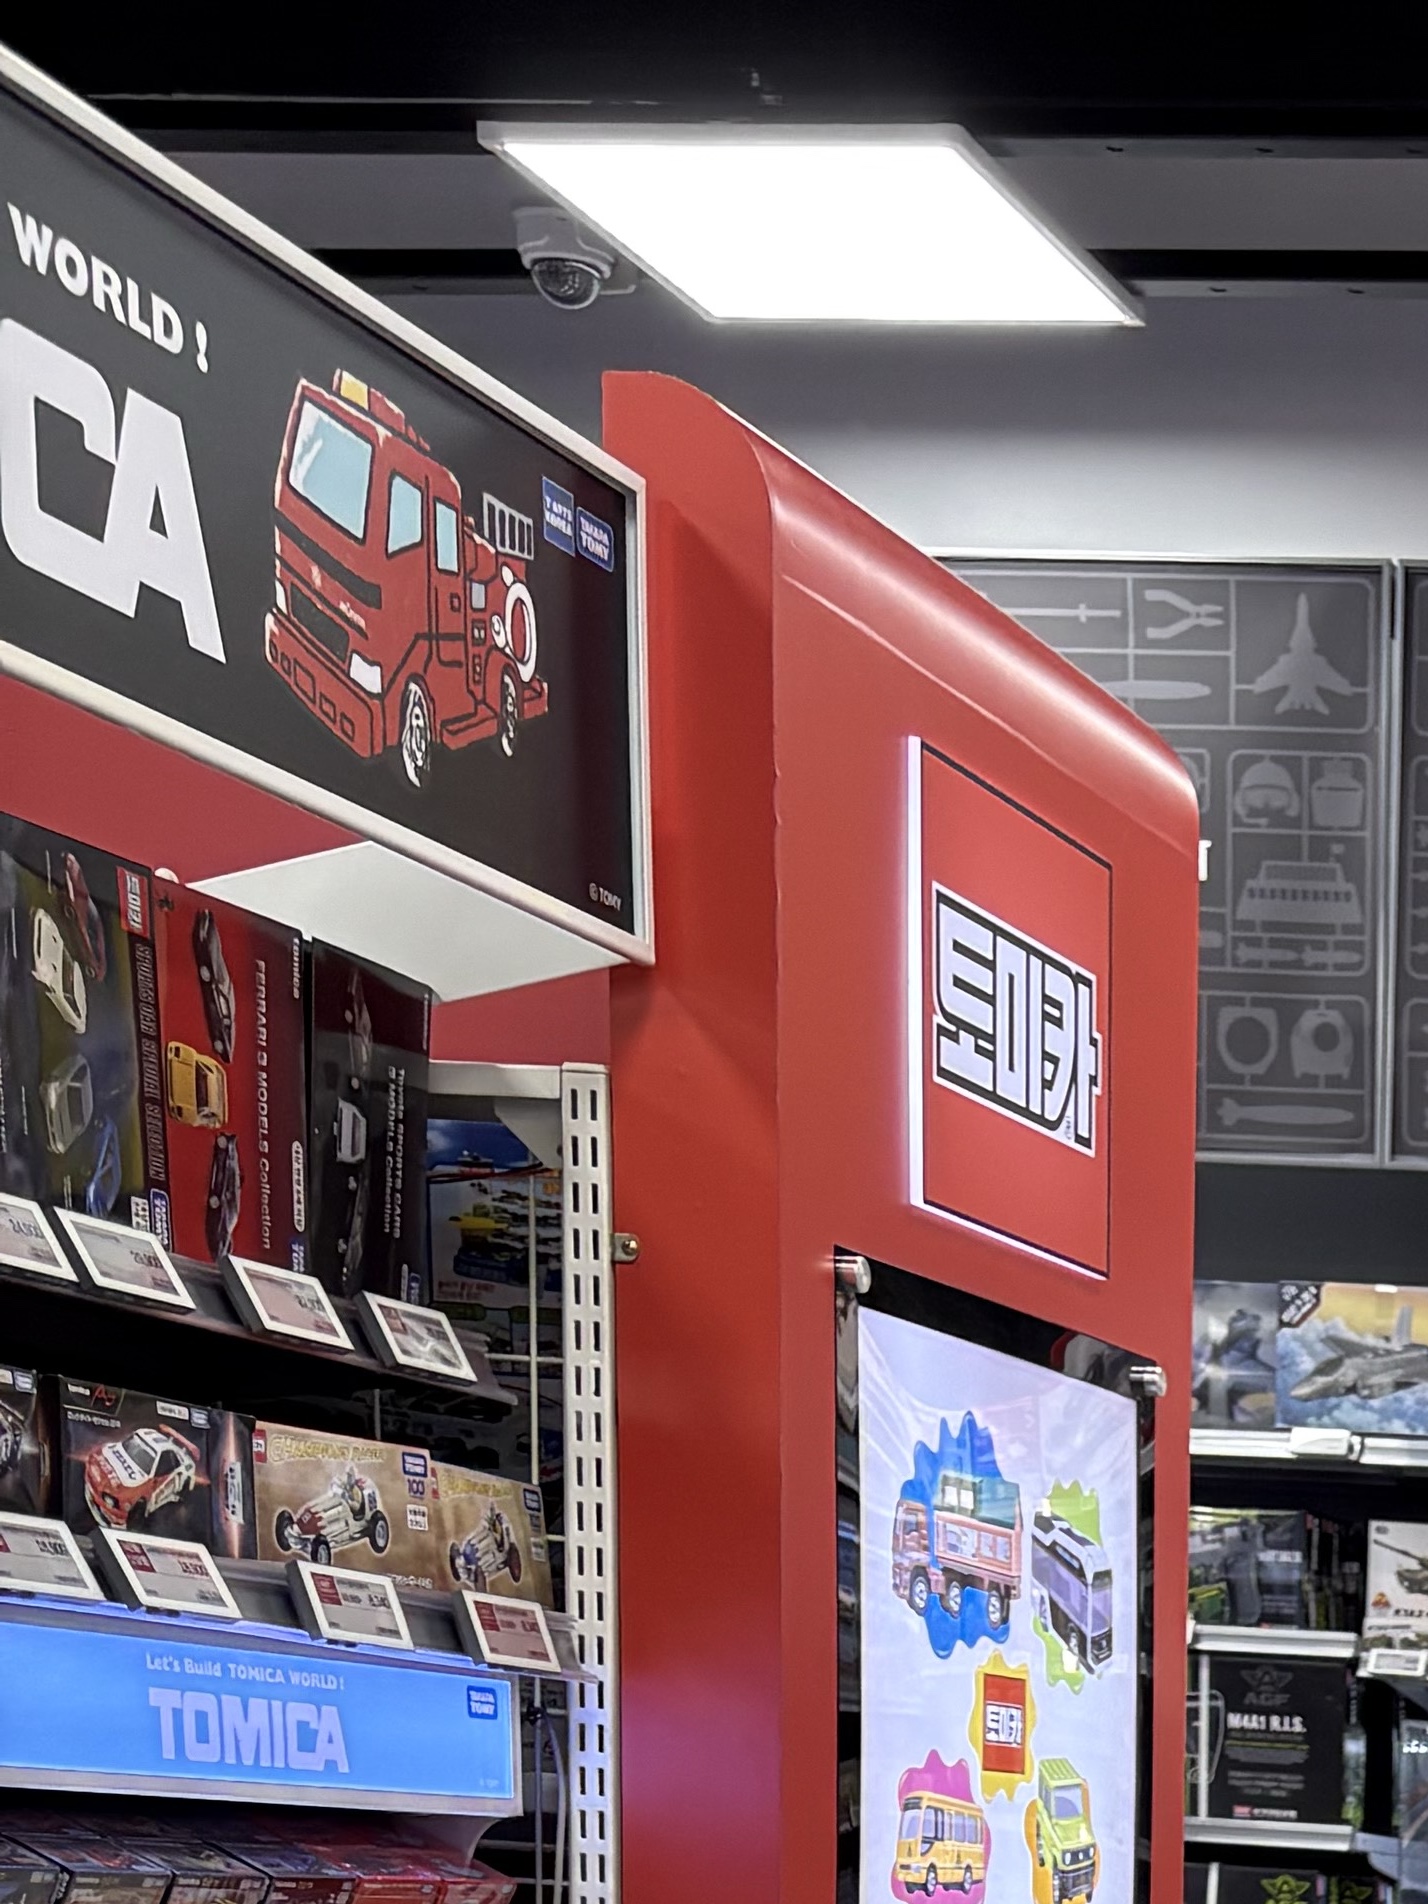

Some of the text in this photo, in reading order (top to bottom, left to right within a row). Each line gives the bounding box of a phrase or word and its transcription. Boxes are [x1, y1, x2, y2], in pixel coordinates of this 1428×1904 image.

[10, 207, 184, 356] WORLD
[580, 531, 609, 561] TOMY
[255, 960, 271, 1250] FERRARI MODELS Collection
[145, 1652, 181, 1675] Let's
[184, 1657, 222, 1679] Build
[227, 1663, 286, 1686] TOMICA
[289, 1669, 337, 1691] WORLD
[149, 1686, 349, 1774] TOMICA
